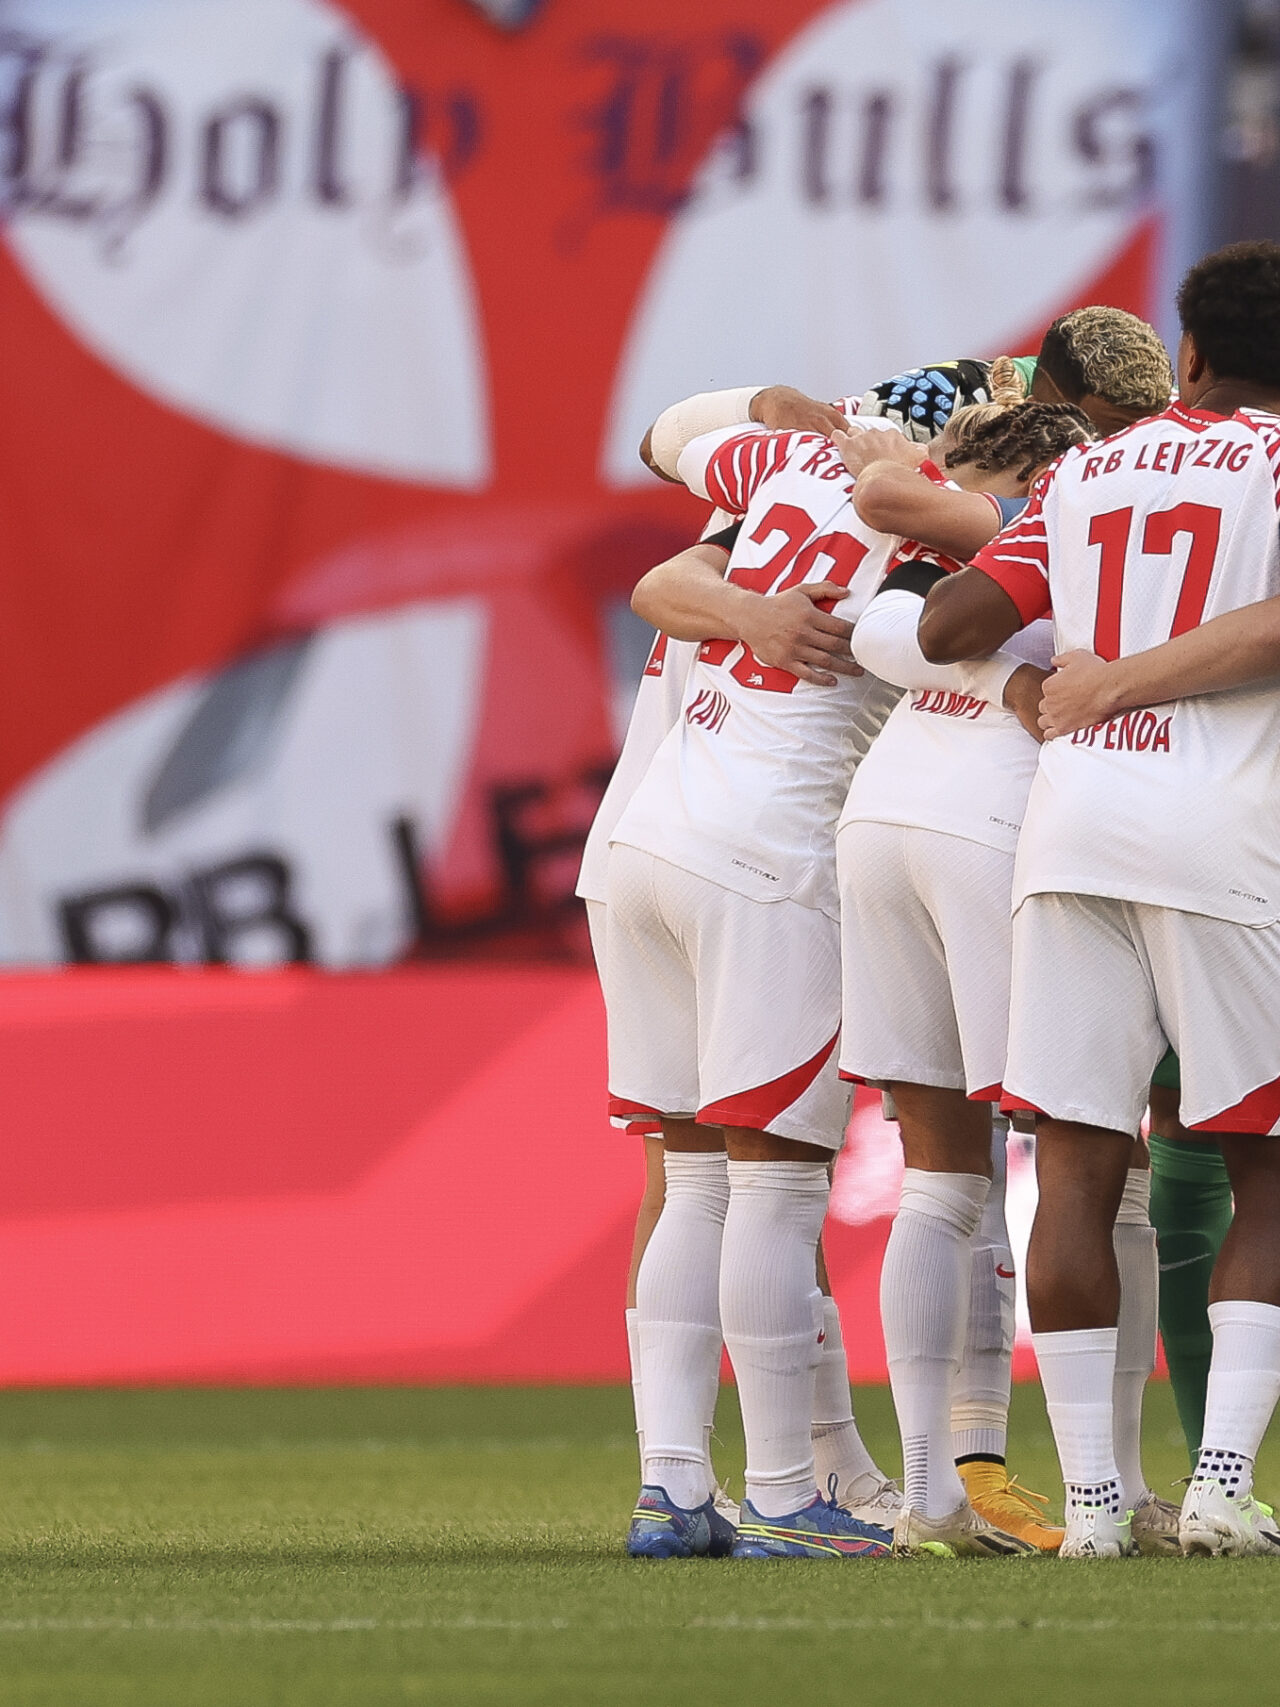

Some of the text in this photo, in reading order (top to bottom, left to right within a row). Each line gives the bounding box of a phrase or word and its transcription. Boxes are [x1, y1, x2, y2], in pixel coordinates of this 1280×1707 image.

[799, 449, 850, 480] RB
[1081, 449, 1125, 482] RB
[1088, 501, 1223, 662] 17
[55, 762, 614, 963] RB LE
